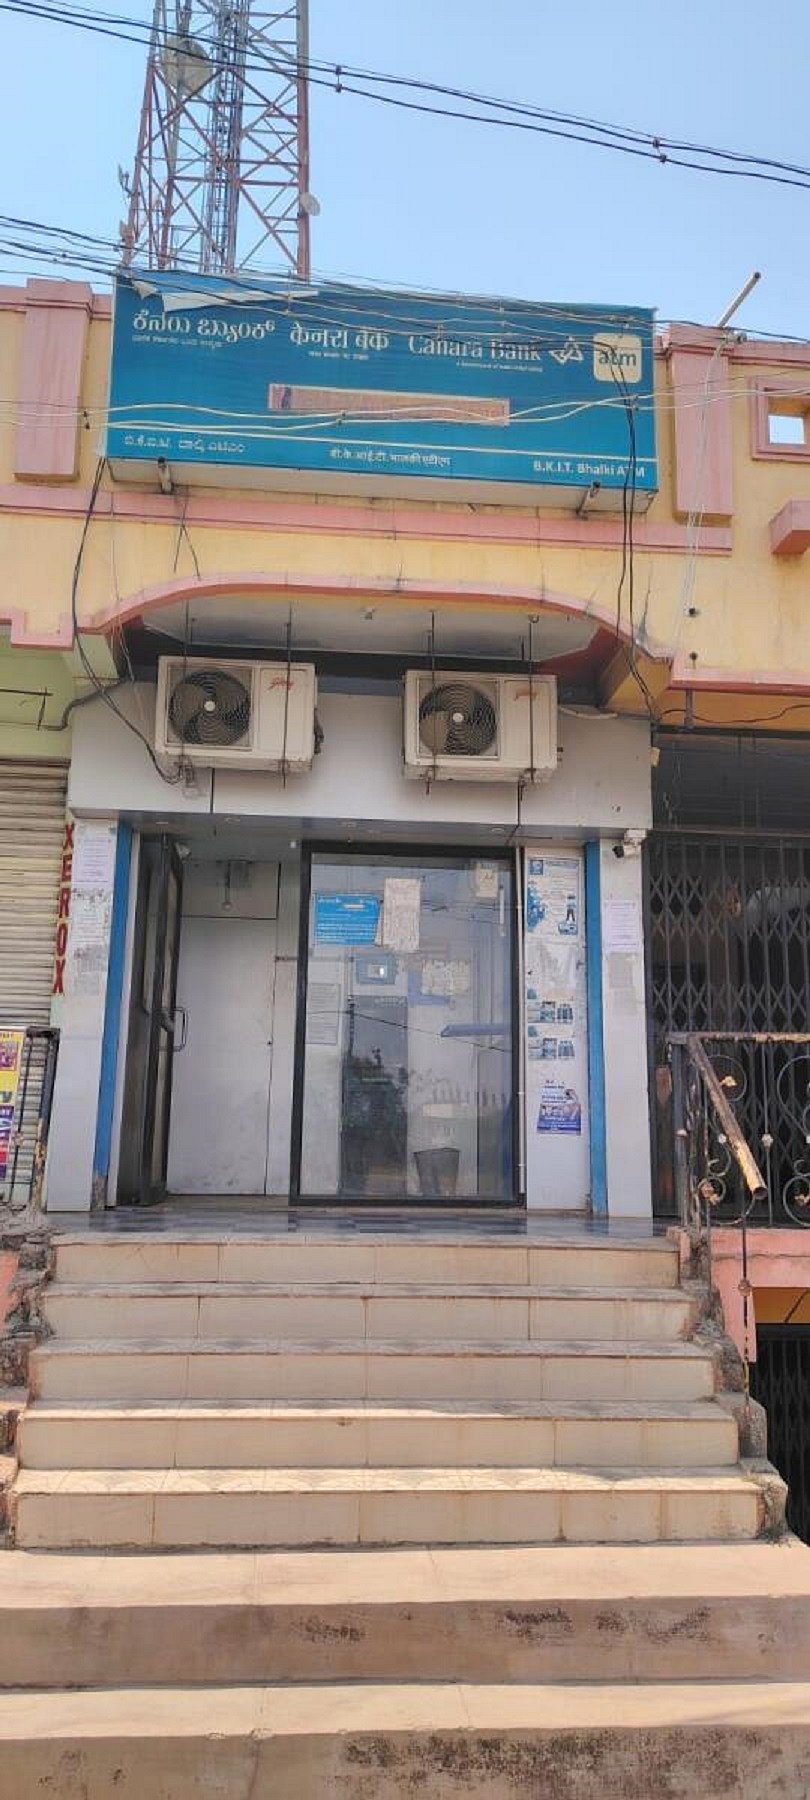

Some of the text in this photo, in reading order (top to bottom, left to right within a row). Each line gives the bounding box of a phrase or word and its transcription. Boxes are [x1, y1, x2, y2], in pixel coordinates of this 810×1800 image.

[197, 318, 276, 343] ಬ್ಯಾಂಕ್
[289, 321, 348, 348] केनरा
[408, 336, 541, 361] Canara Bank
[599, 350, 637, 366] atm
[577, 463, 615, 476] Bhalki
[52, 822, 75, 994] XEROX
